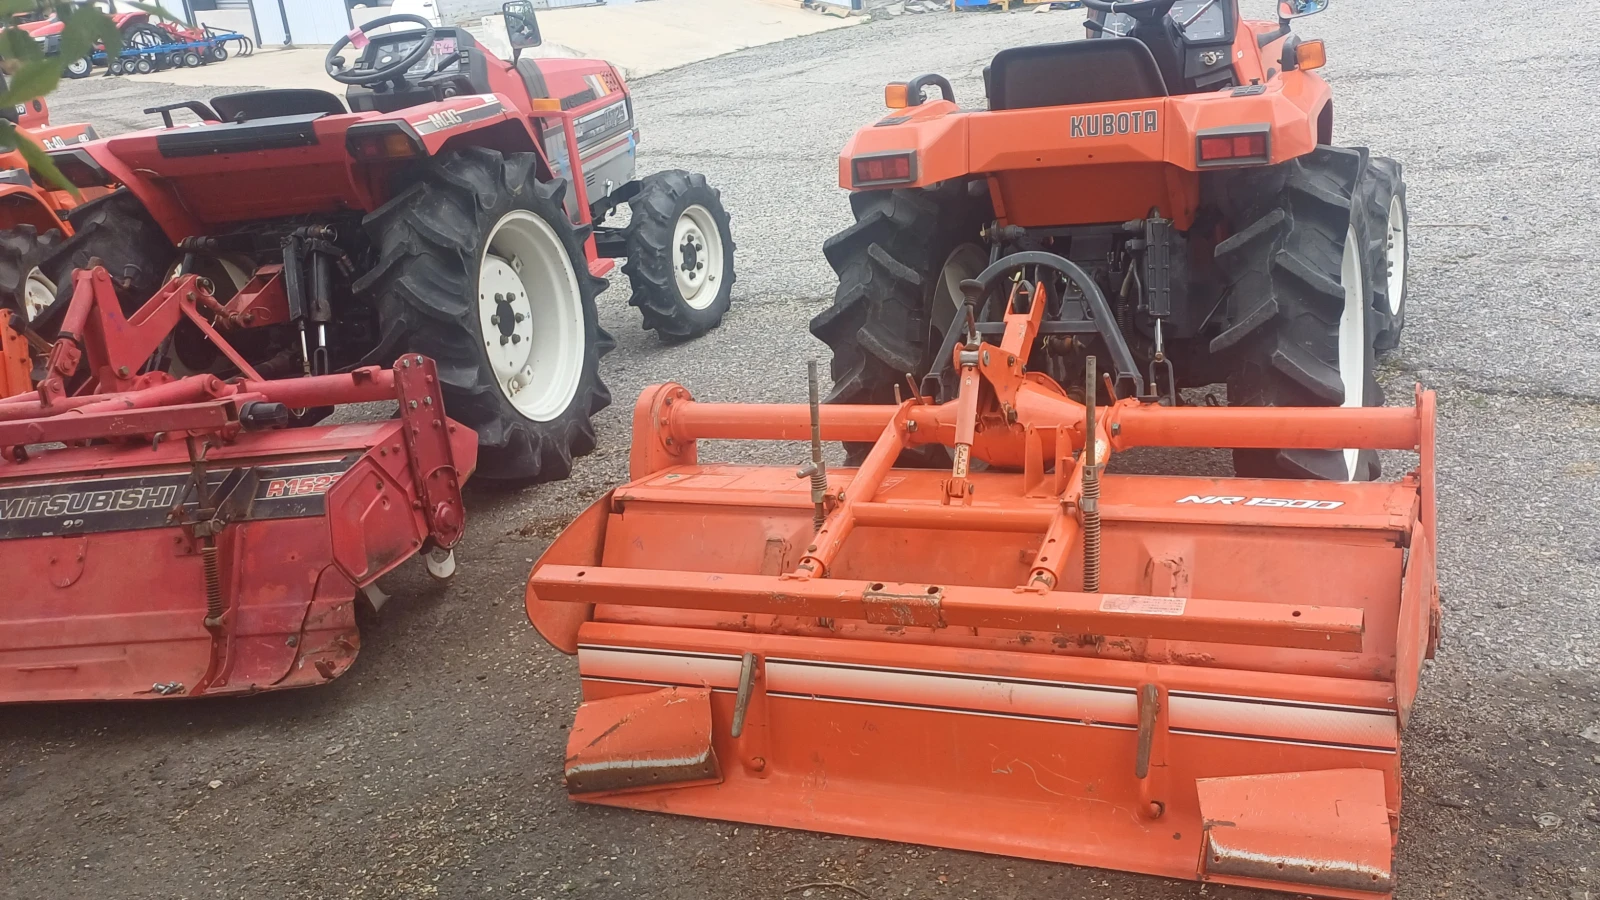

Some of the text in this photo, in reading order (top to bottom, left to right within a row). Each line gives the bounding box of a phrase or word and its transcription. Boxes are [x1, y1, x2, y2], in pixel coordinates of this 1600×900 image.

[427, 109, 463, 128] MAC
[1070, 109, 1158, 138] KUBOTA
[0, 485, 178, 520] MITSUBISHI
[1175, 495, 1346, 510] NR 1500
